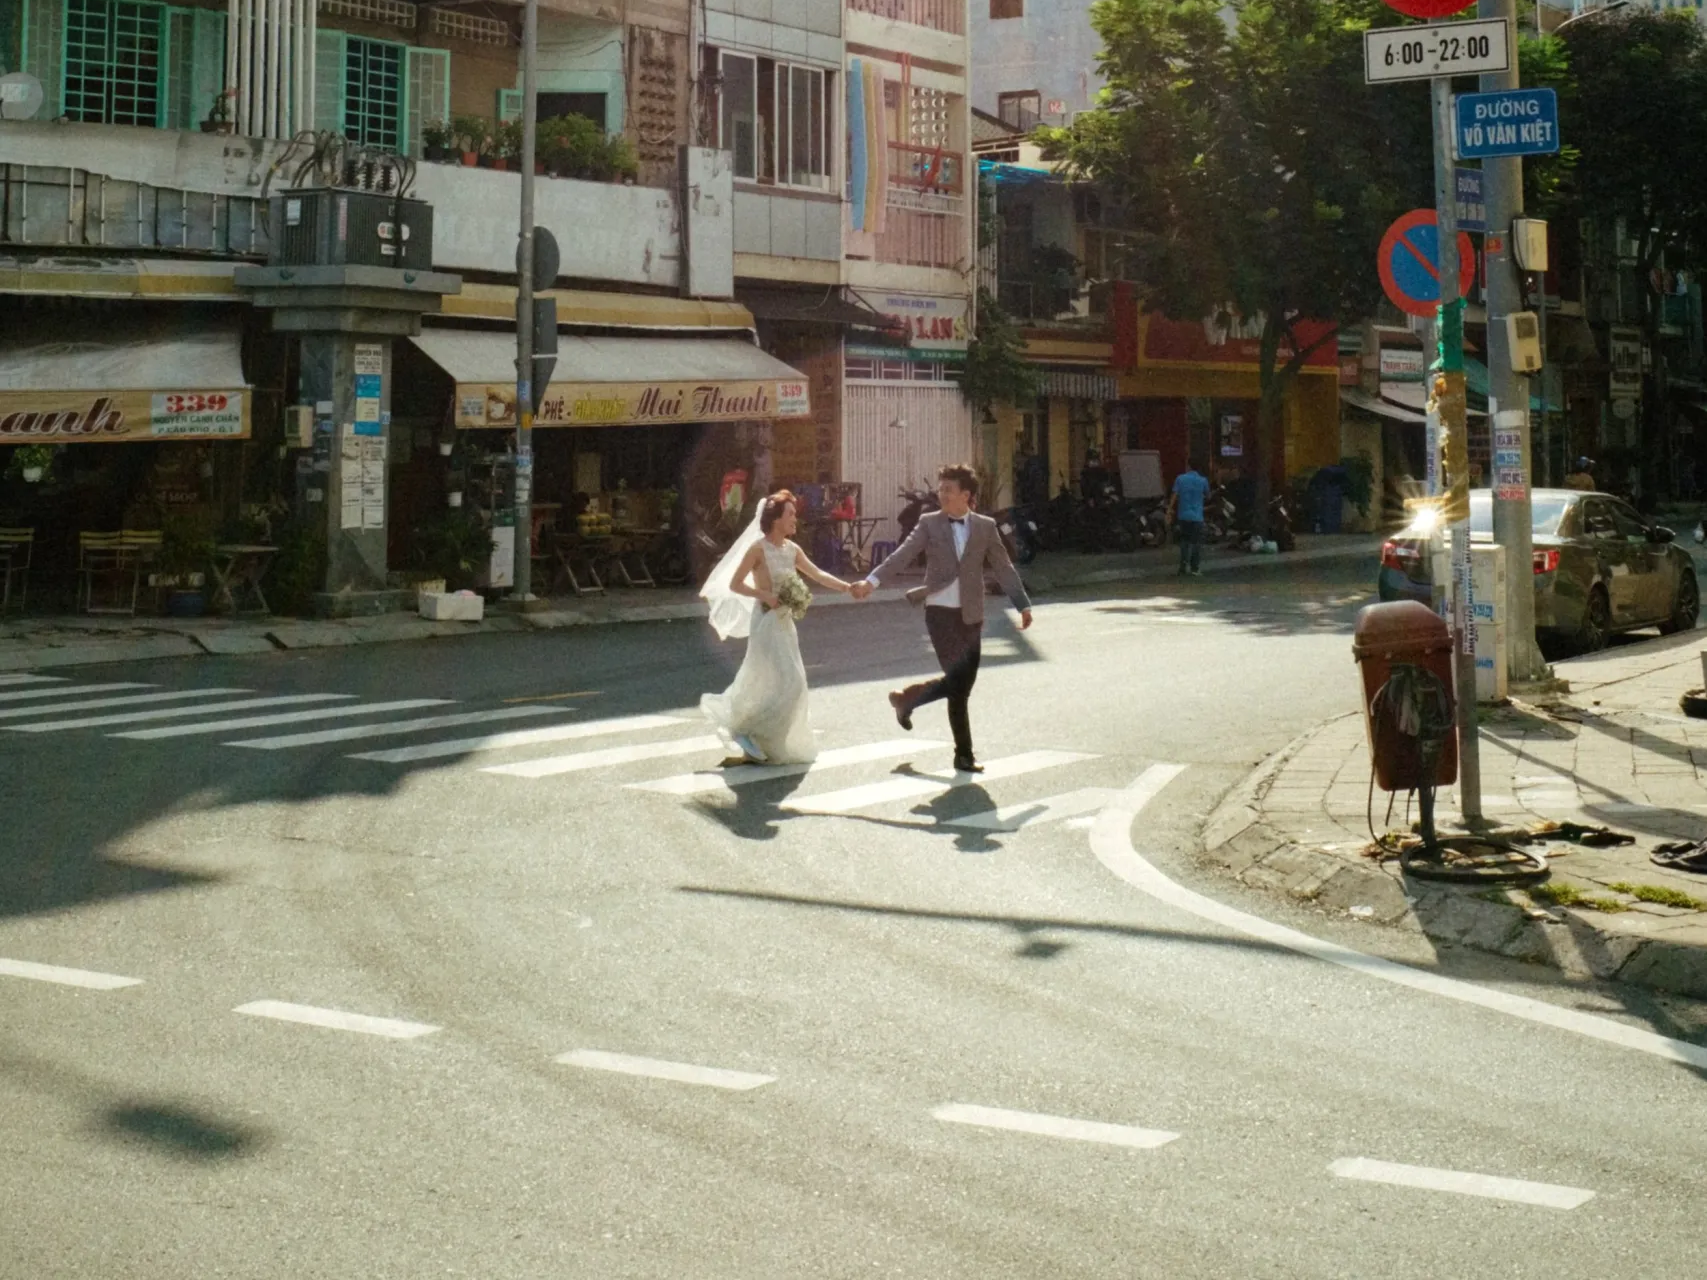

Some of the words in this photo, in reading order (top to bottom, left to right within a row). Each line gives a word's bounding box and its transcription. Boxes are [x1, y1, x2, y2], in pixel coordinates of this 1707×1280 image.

[1475, 98, 1540, 119] ĐƯỜNG
[1464, 123, 1483, 147] VÕ
[1486, 121, 1518, 145] VĂN
[1520, 119, 1553, 147] KIỆT
[166, 395, 228, 413] 339
[631, 387, 685, 419] Mai
